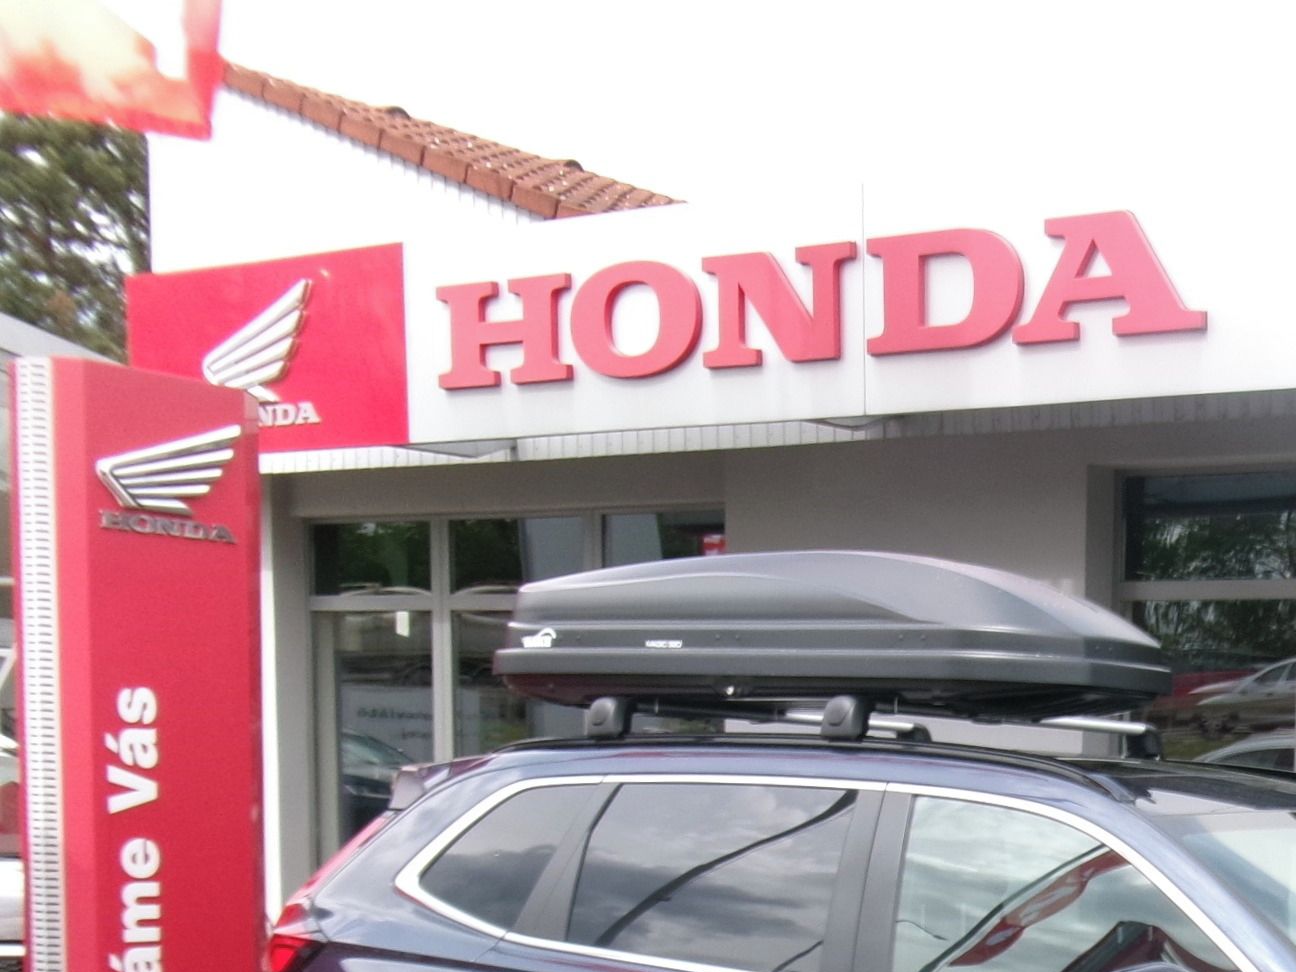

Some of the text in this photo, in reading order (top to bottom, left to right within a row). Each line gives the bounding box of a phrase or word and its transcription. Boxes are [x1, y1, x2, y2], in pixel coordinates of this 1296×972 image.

[436, 209, 1208, 391] HONDA
[258, 401, 322, 427] NDA
[100, 510, 237, 544] HONDA
[104, 685, 159, 815] Vás
